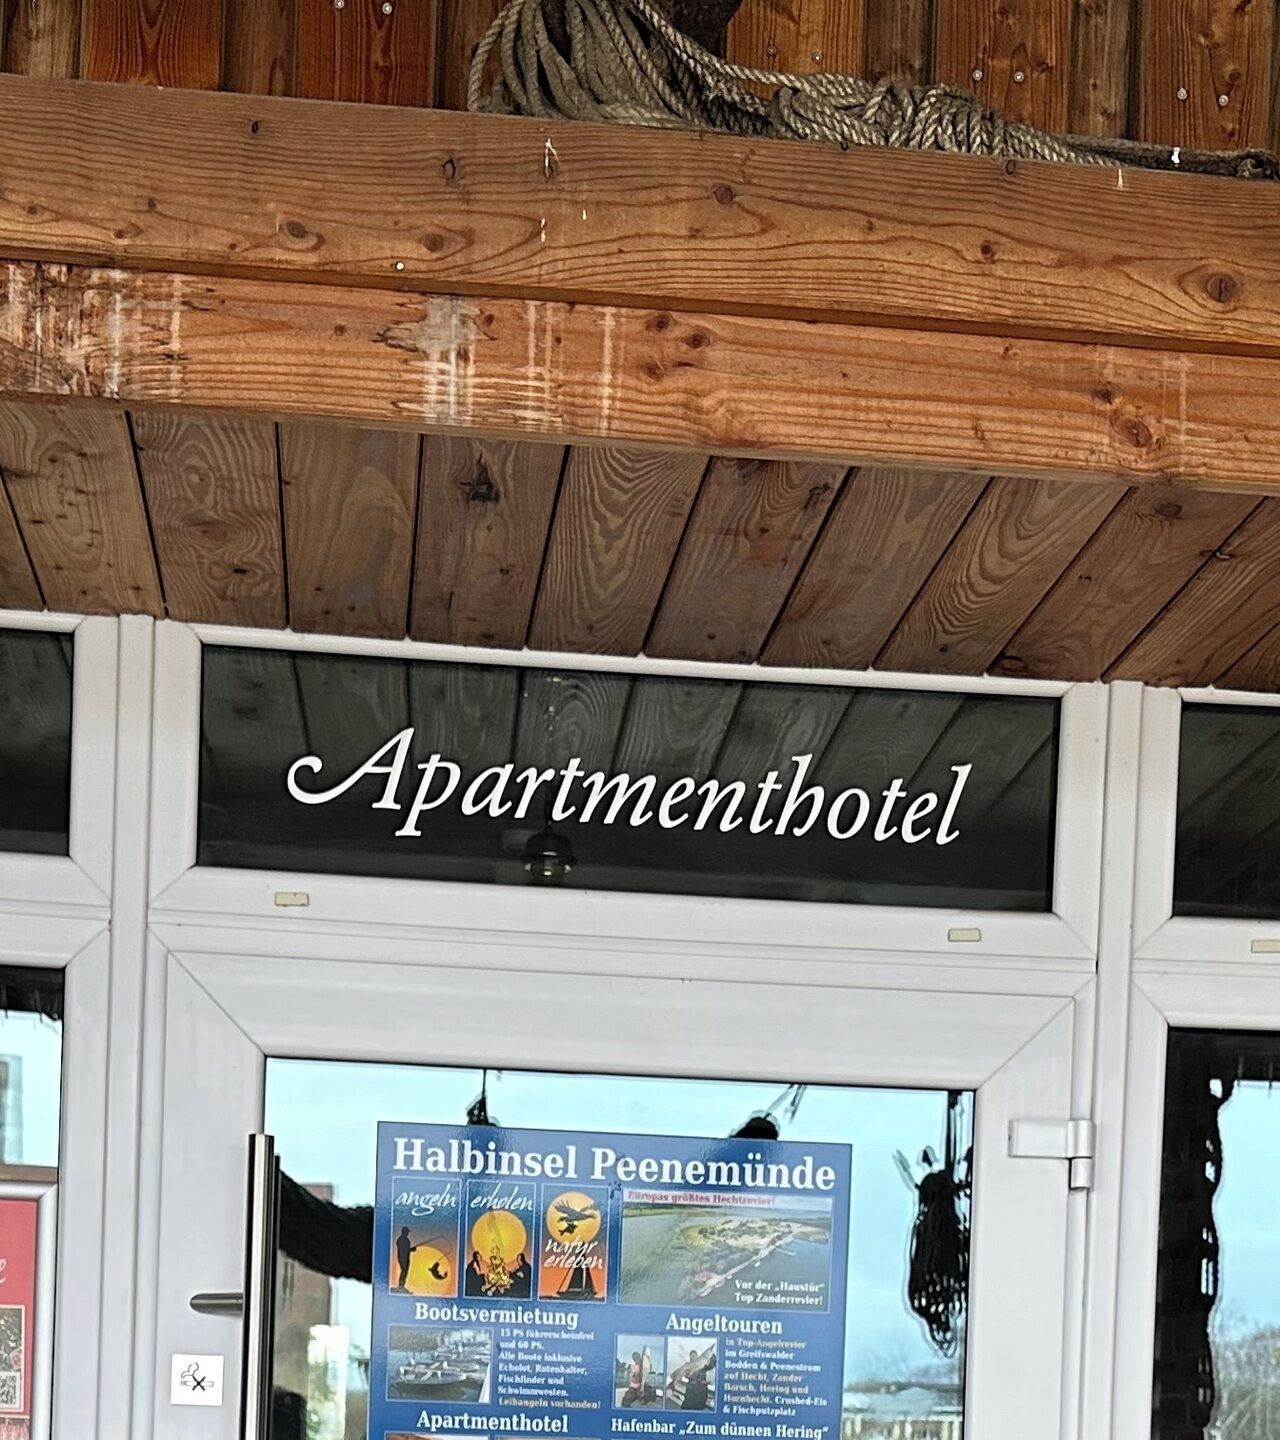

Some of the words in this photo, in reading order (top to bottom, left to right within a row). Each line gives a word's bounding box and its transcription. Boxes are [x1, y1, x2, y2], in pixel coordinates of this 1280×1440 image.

[287, 727, 972, 846] Apartmenthotel
[393, 1137, 577, 1178] Halbinsel
[591, 1148, 836, 1190] Peenemünde
[395, 1183, 457, 1216] angeln
[471, 1183, 533, 1210] erholen
[545, 1235, 598, 1253] natur
[544, 1252, 603, 1268] erleben
[735, 1280, 753, 1289] Vor
[755, 1280, 772, 1290] der
[735, 1293, 753, 1304] Top
[415, 1304, 578, 1328] Bootsvermietung
[666, 1313, 783, 1334] Angeltouren
[513, 1329, 524, 1337] PS
[499, 1352, 515, 1360] Alle
[739, 1350, 795, 1359] Greifswalder
[760, 1361, 767, 1370] &
[770, 1362, 821, 1371] Peenestrom
[548, 1376, 564, 1385] und
[723, 1405, 730, 1413] &
[417, 1410, 568, 1433] Apartmenthotel
[611, 1418, 674, 1433] Hafenbar
[678, 1421, 717, 1437] „Zum
[720, 1421, 771, 1438] dünnen
[776, 1424, 828, 1440] Hering“
